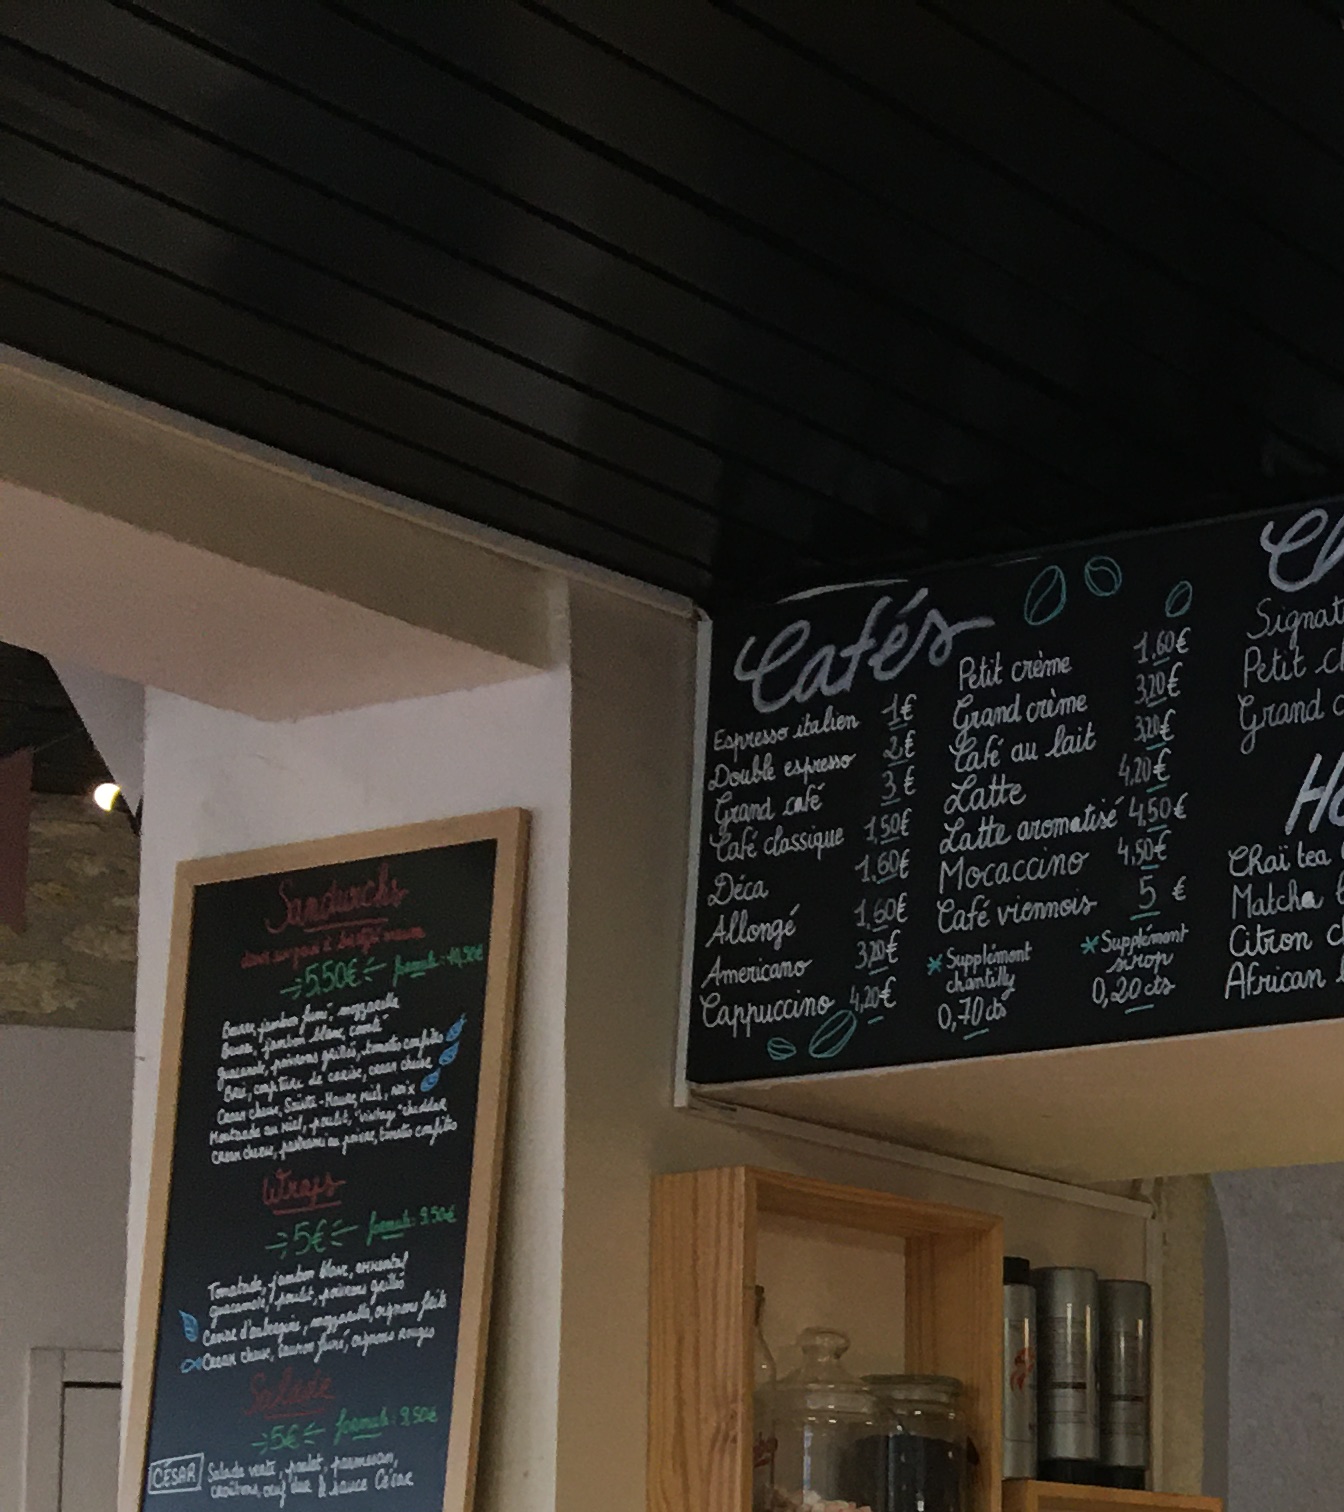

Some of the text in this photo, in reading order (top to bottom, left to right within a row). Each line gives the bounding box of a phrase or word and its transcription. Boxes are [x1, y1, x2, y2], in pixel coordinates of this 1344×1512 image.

[733, 588, 995, 712] Cafés
[959, 651, 1072, 691] Petit crème
[714, 706, 860, 761] Espresso italien
[943, 775, 1026, 814] Latte
[708, 874, 769, 905] Déca
[939, 849, 1090, 894] Mocaccino
[936, 892, 1097, 934] Café viennois
[1231, 889, 1324, 921] Matcha
[1229, 928, 1312, 957] Citron
[702, 959, 812, 988] Americano
[701, 990, 834, 1038] Cappuccino
[152, 1461, 196, 1486] CÉSAR
